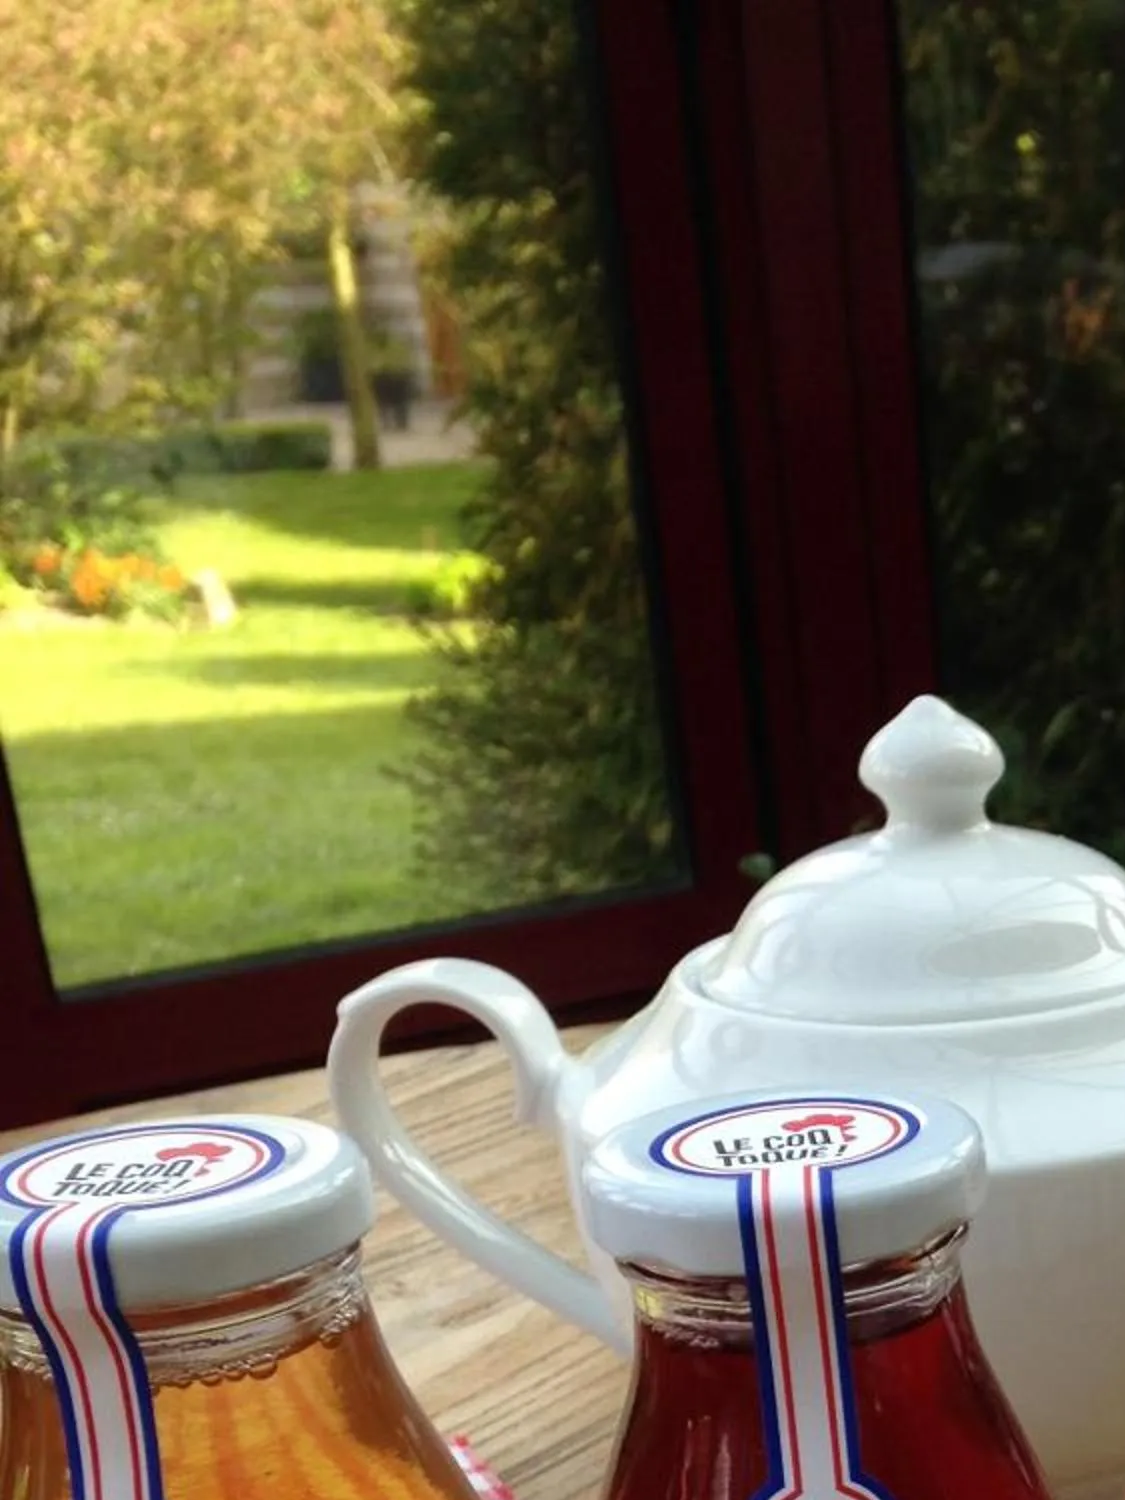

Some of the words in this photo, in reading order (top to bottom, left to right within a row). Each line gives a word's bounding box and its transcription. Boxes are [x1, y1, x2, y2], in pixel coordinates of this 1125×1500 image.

[712, 1137, 752, 1154] LE
[763, 1129, 833, 1150] COQ
[65, 1163, 114, 1180] LE
[117, 1159, 193, 1178] COQ
